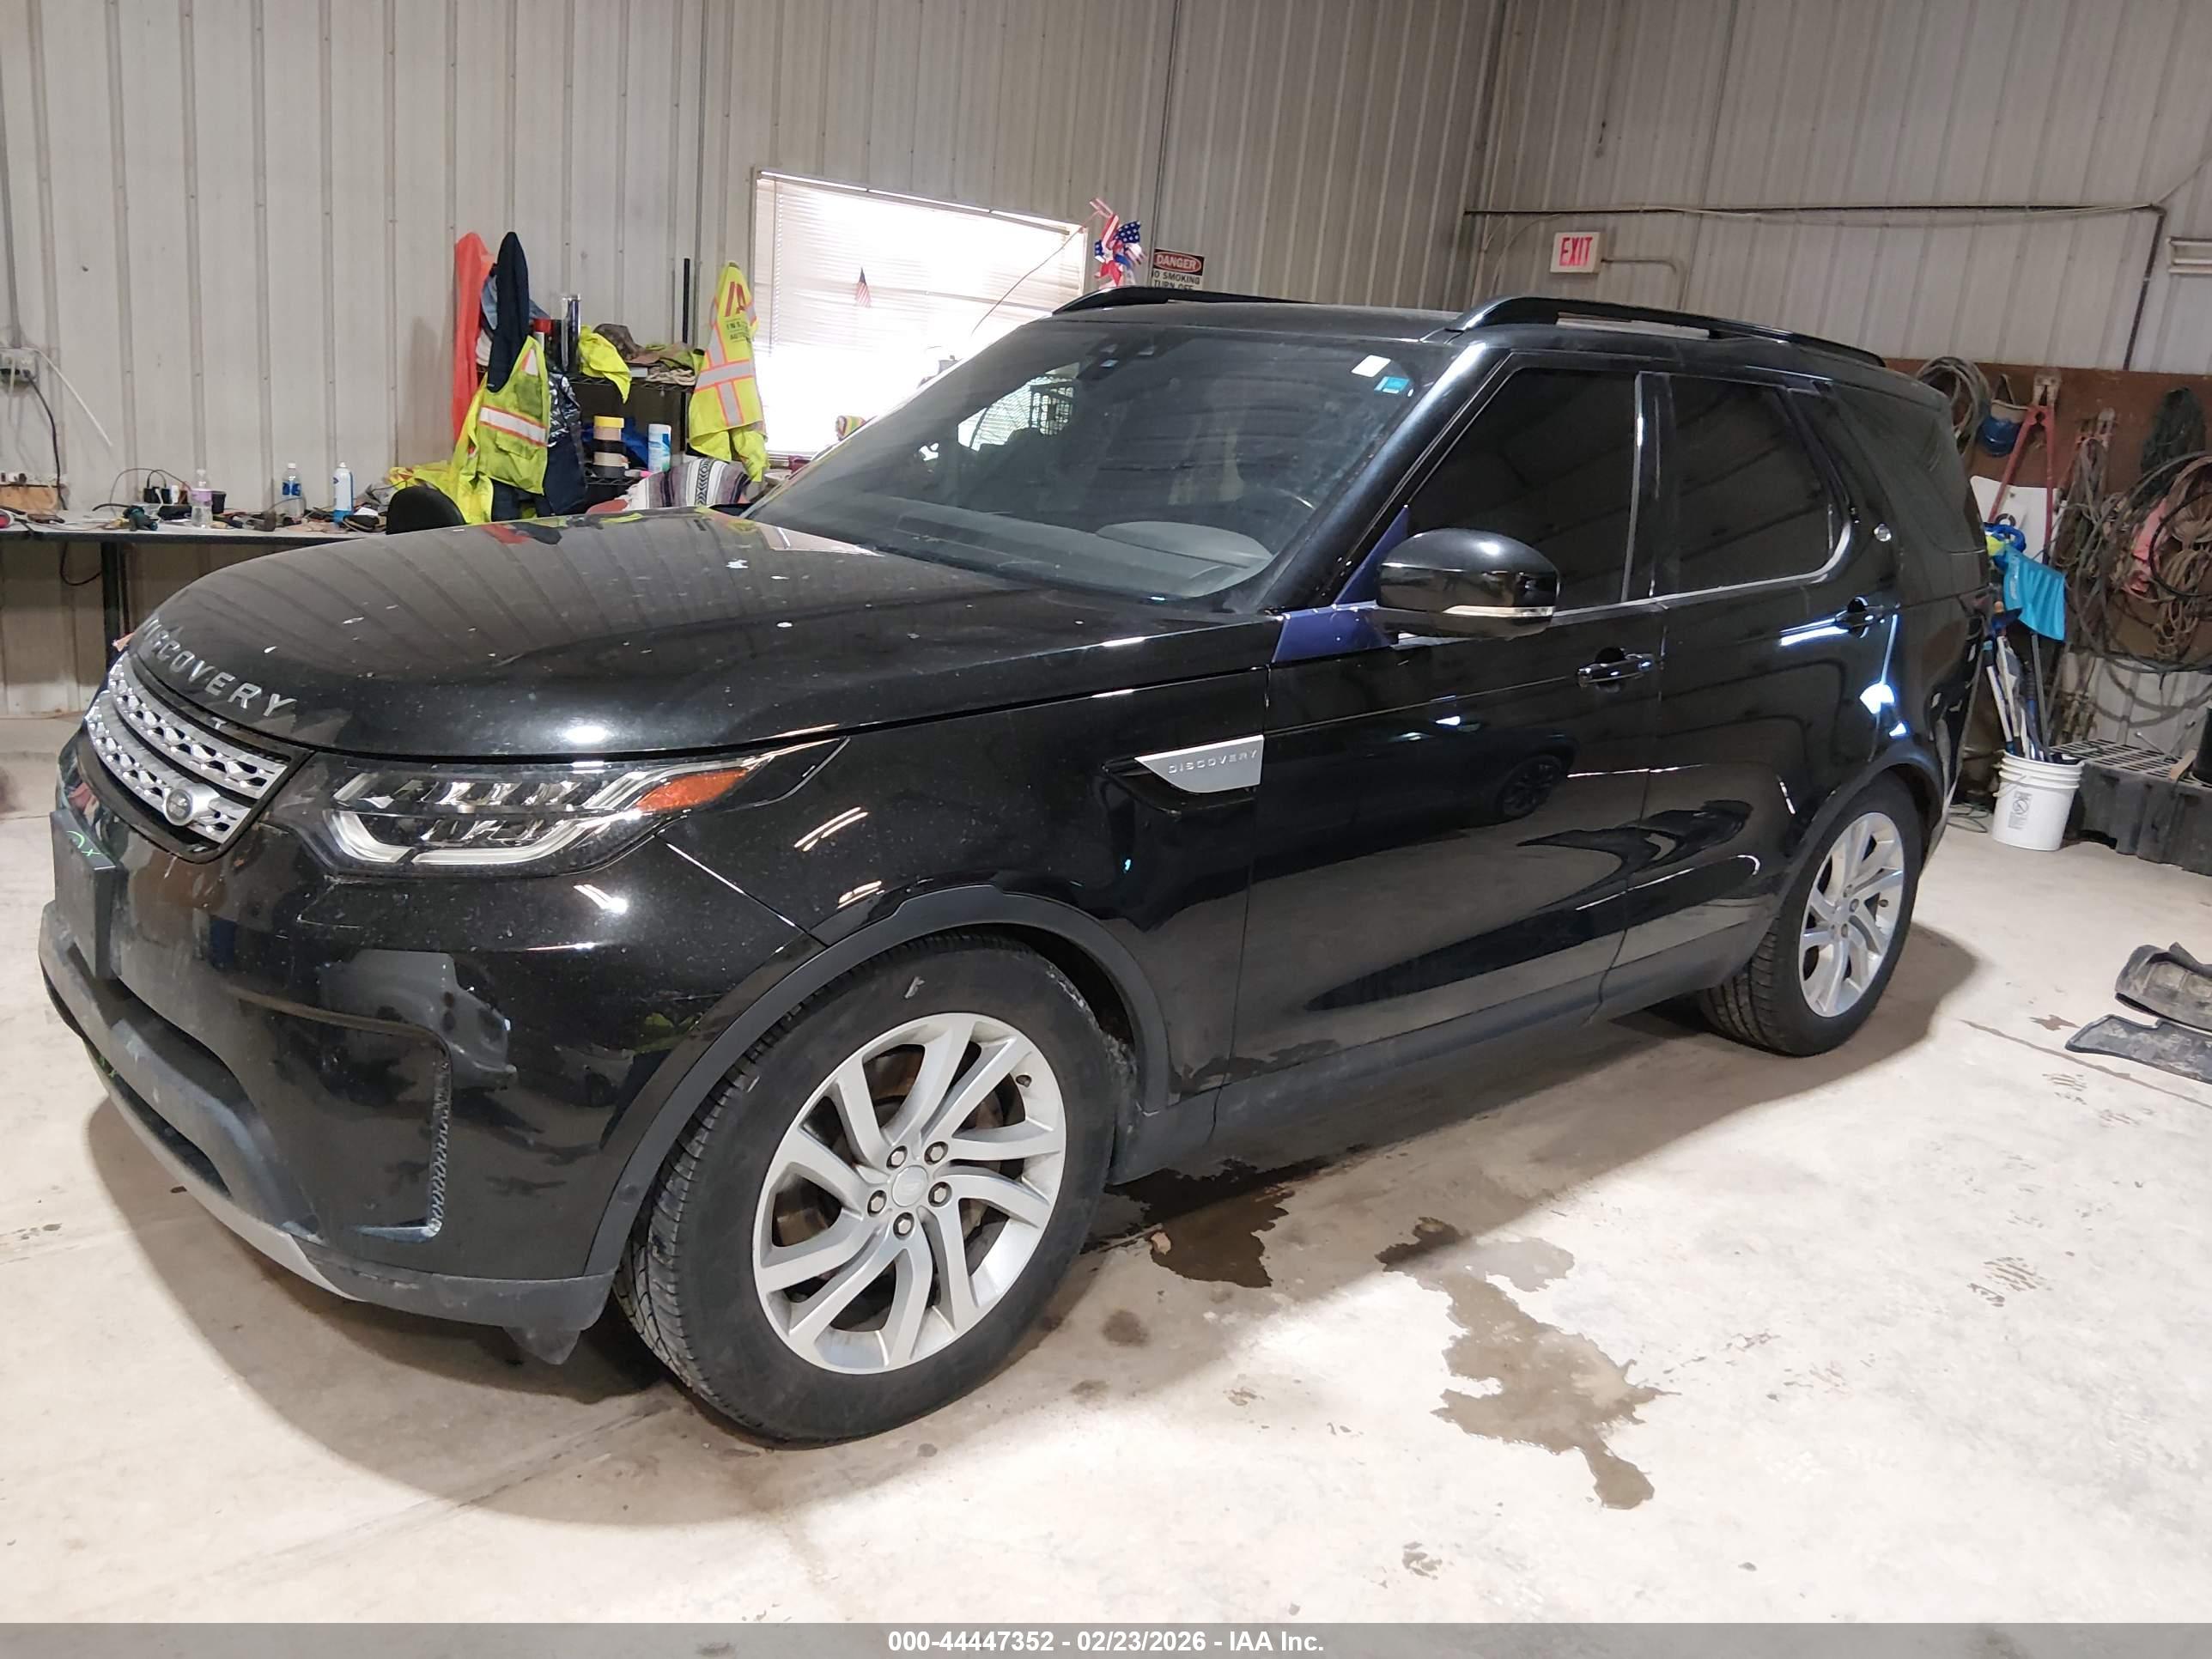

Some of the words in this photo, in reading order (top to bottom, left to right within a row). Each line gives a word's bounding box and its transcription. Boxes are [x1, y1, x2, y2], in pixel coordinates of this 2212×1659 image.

[1559, 237, 1593, 266] EXIT
[1157, 254, 1197, 270] DANGER
[1163, 271, 1200, 284] SMOKING
[1168, 749, 1258, 774] DISCOVERY
